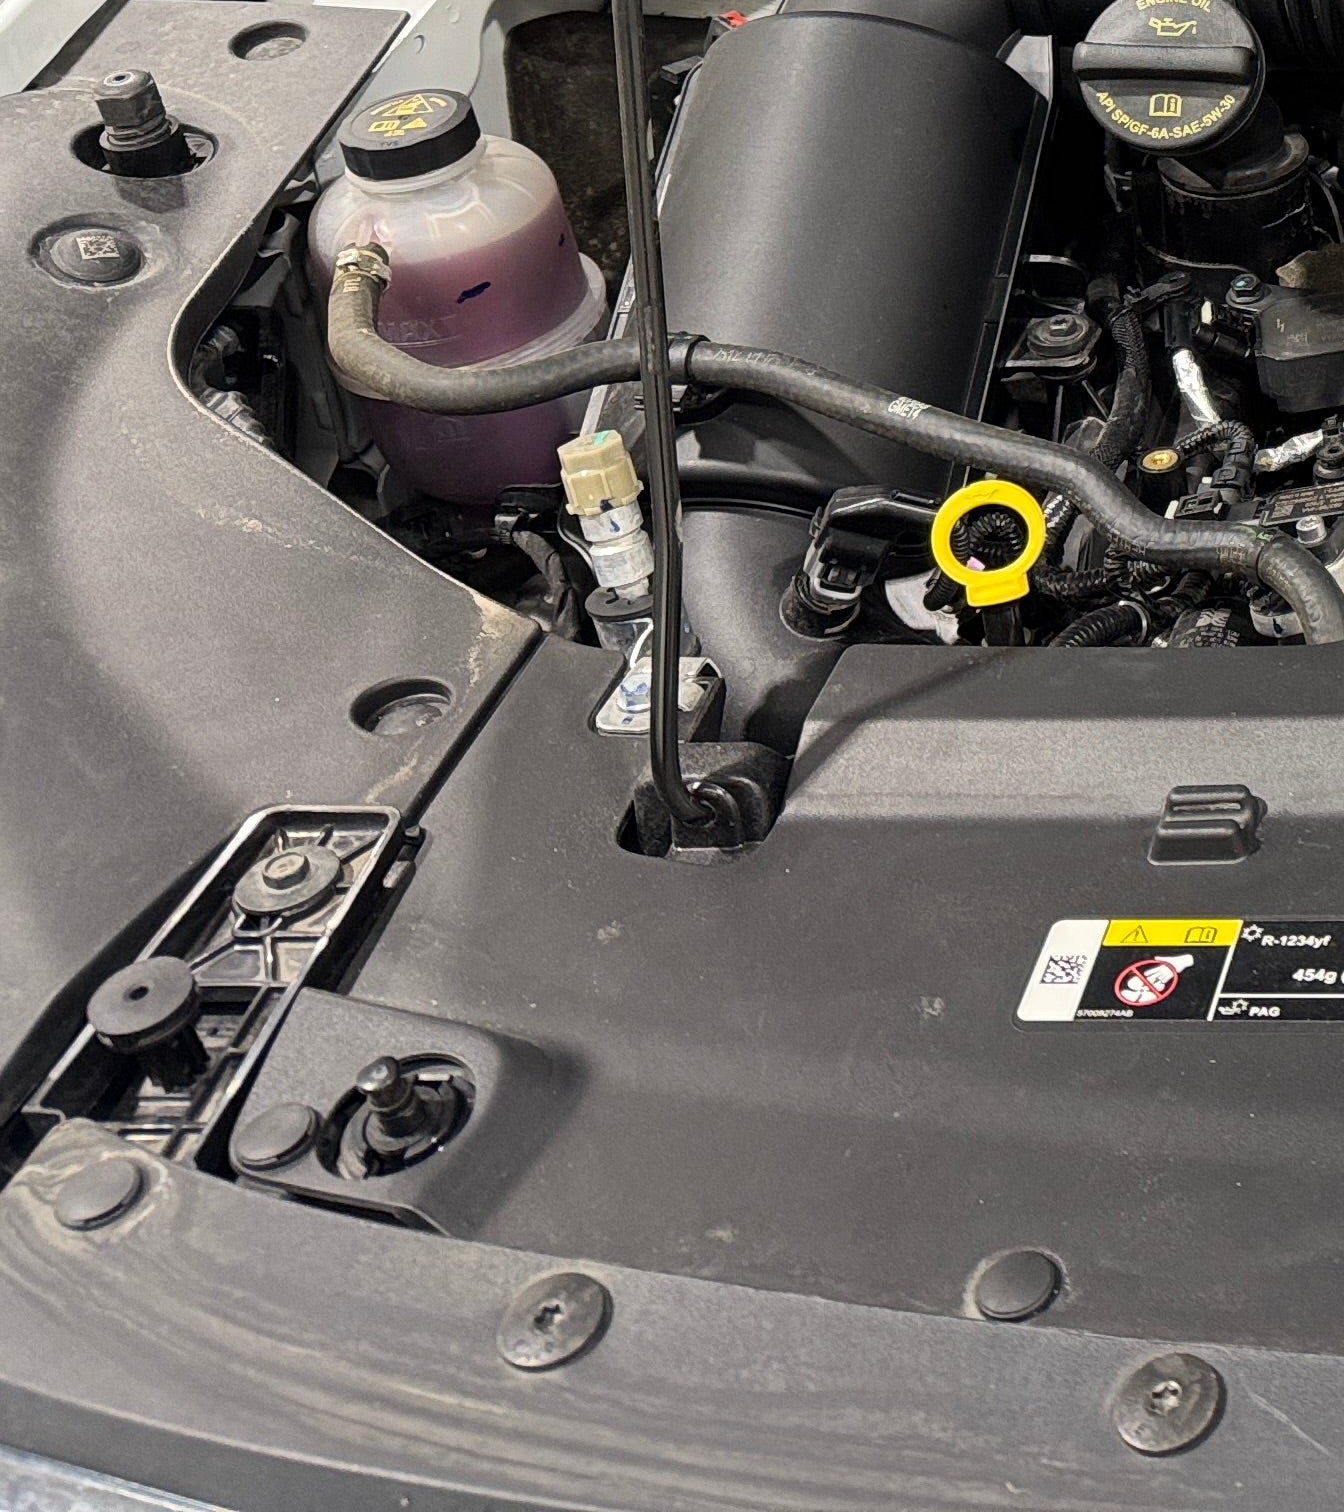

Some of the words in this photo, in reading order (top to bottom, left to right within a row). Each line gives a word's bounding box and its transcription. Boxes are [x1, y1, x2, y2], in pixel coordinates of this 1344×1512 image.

[1096, 91, 1116, 113] API
[1111, 94, 1236, 140] SP/GF-6A-SAE-5W-30
[1261, 935, 1332, 948] R-1234yf
[1292, 969, 1338, 984] 454g
[1248, 1006, 1281, 1017] PAG
